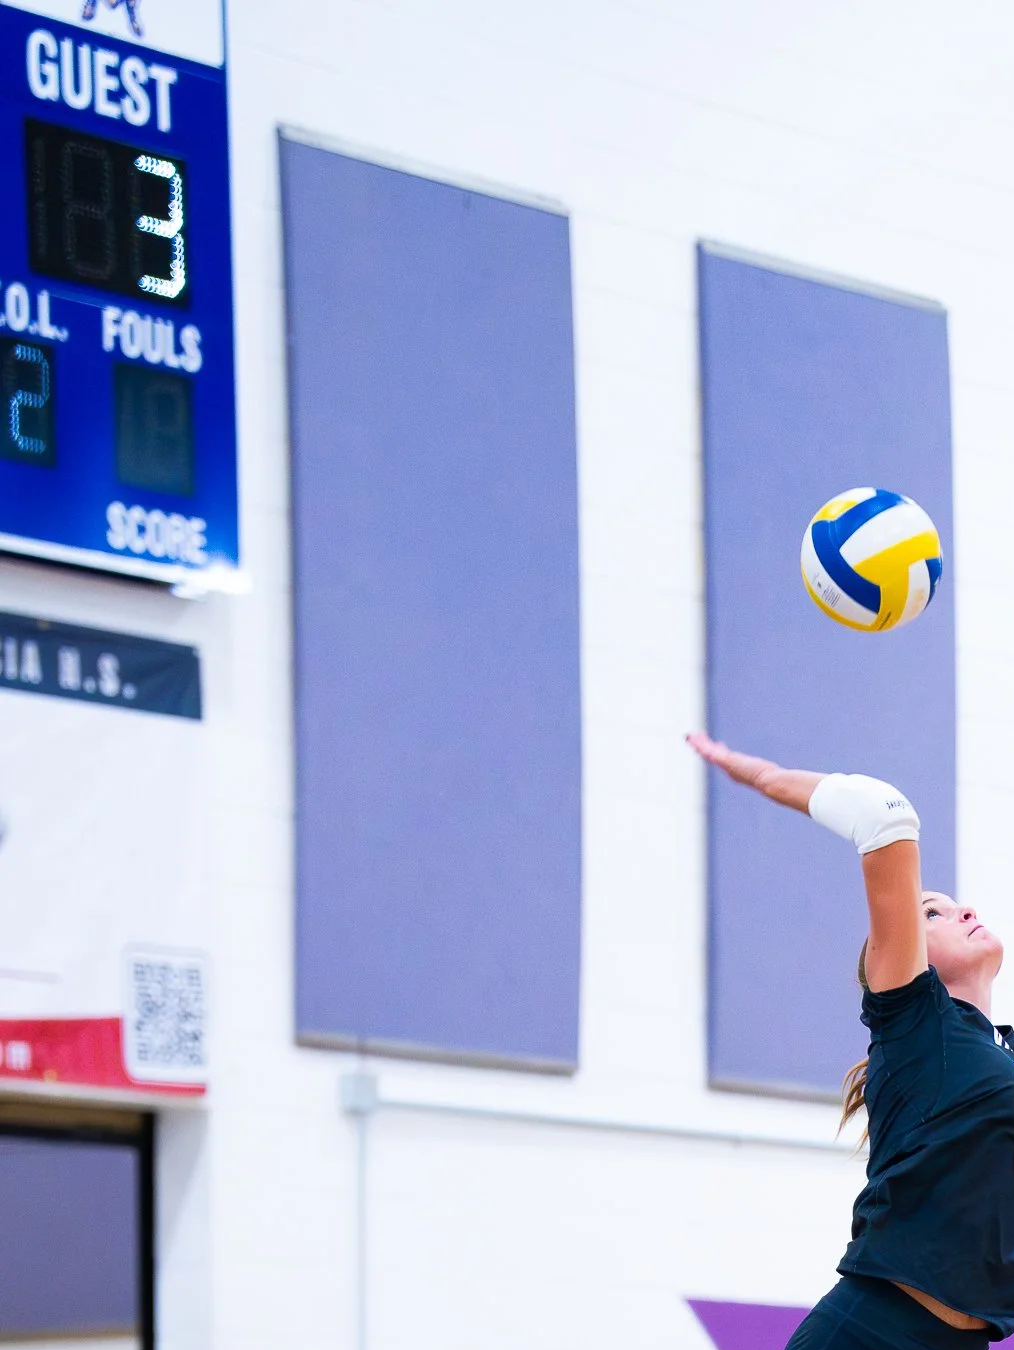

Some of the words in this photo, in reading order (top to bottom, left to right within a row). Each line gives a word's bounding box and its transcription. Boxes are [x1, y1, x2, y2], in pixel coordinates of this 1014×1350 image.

[26, 29, 178, 134] GUEST
[134, 154, 186, 299] 3
[0, 282, 69, 342] .O.L.
[102, 305, 203, 374] FOULS
[9, 344, 50, 454] 2
[106, 500, 208, 566] SCORE
